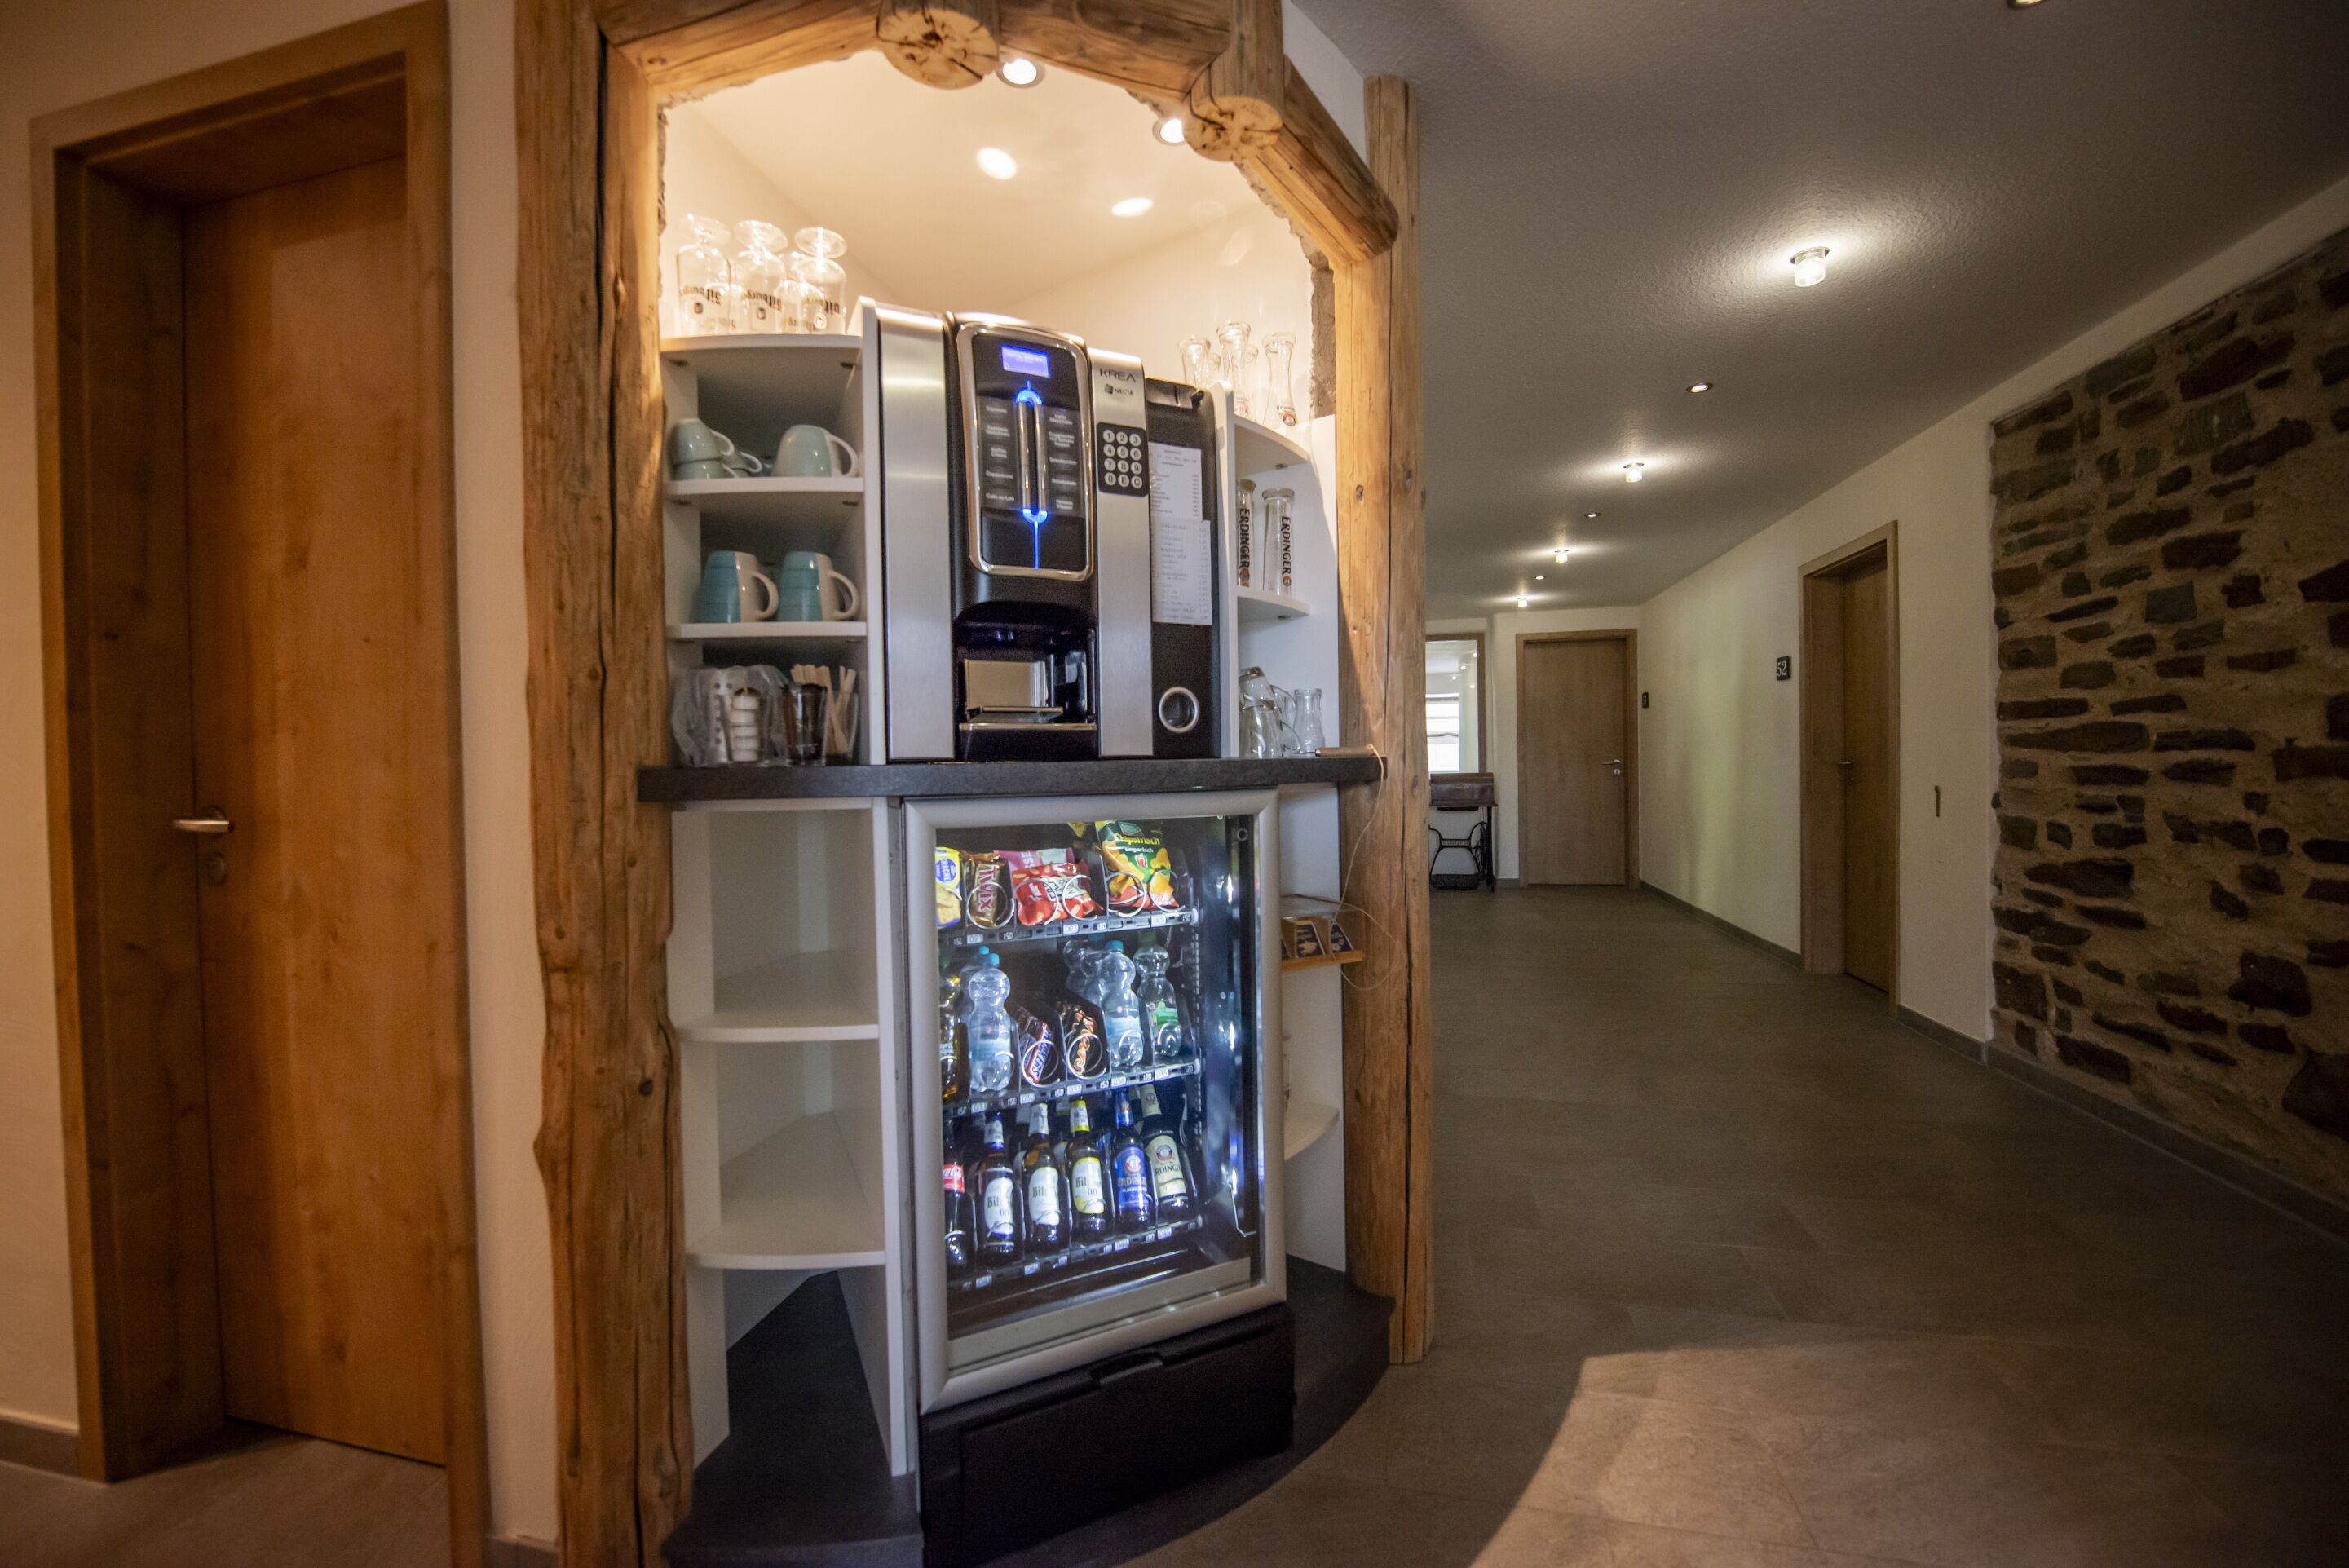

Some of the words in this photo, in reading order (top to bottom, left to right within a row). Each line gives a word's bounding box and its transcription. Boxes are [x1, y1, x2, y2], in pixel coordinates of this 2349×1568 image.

[1100, 368, 1137, 383] KREA
[1115, 387, 1133, 396] NECTA
[1239, 508, 1250, 570] ERDINGER
[1281, 516, 1292, 576] ERDINGER
[1777, 660, 1786, 677] 52
